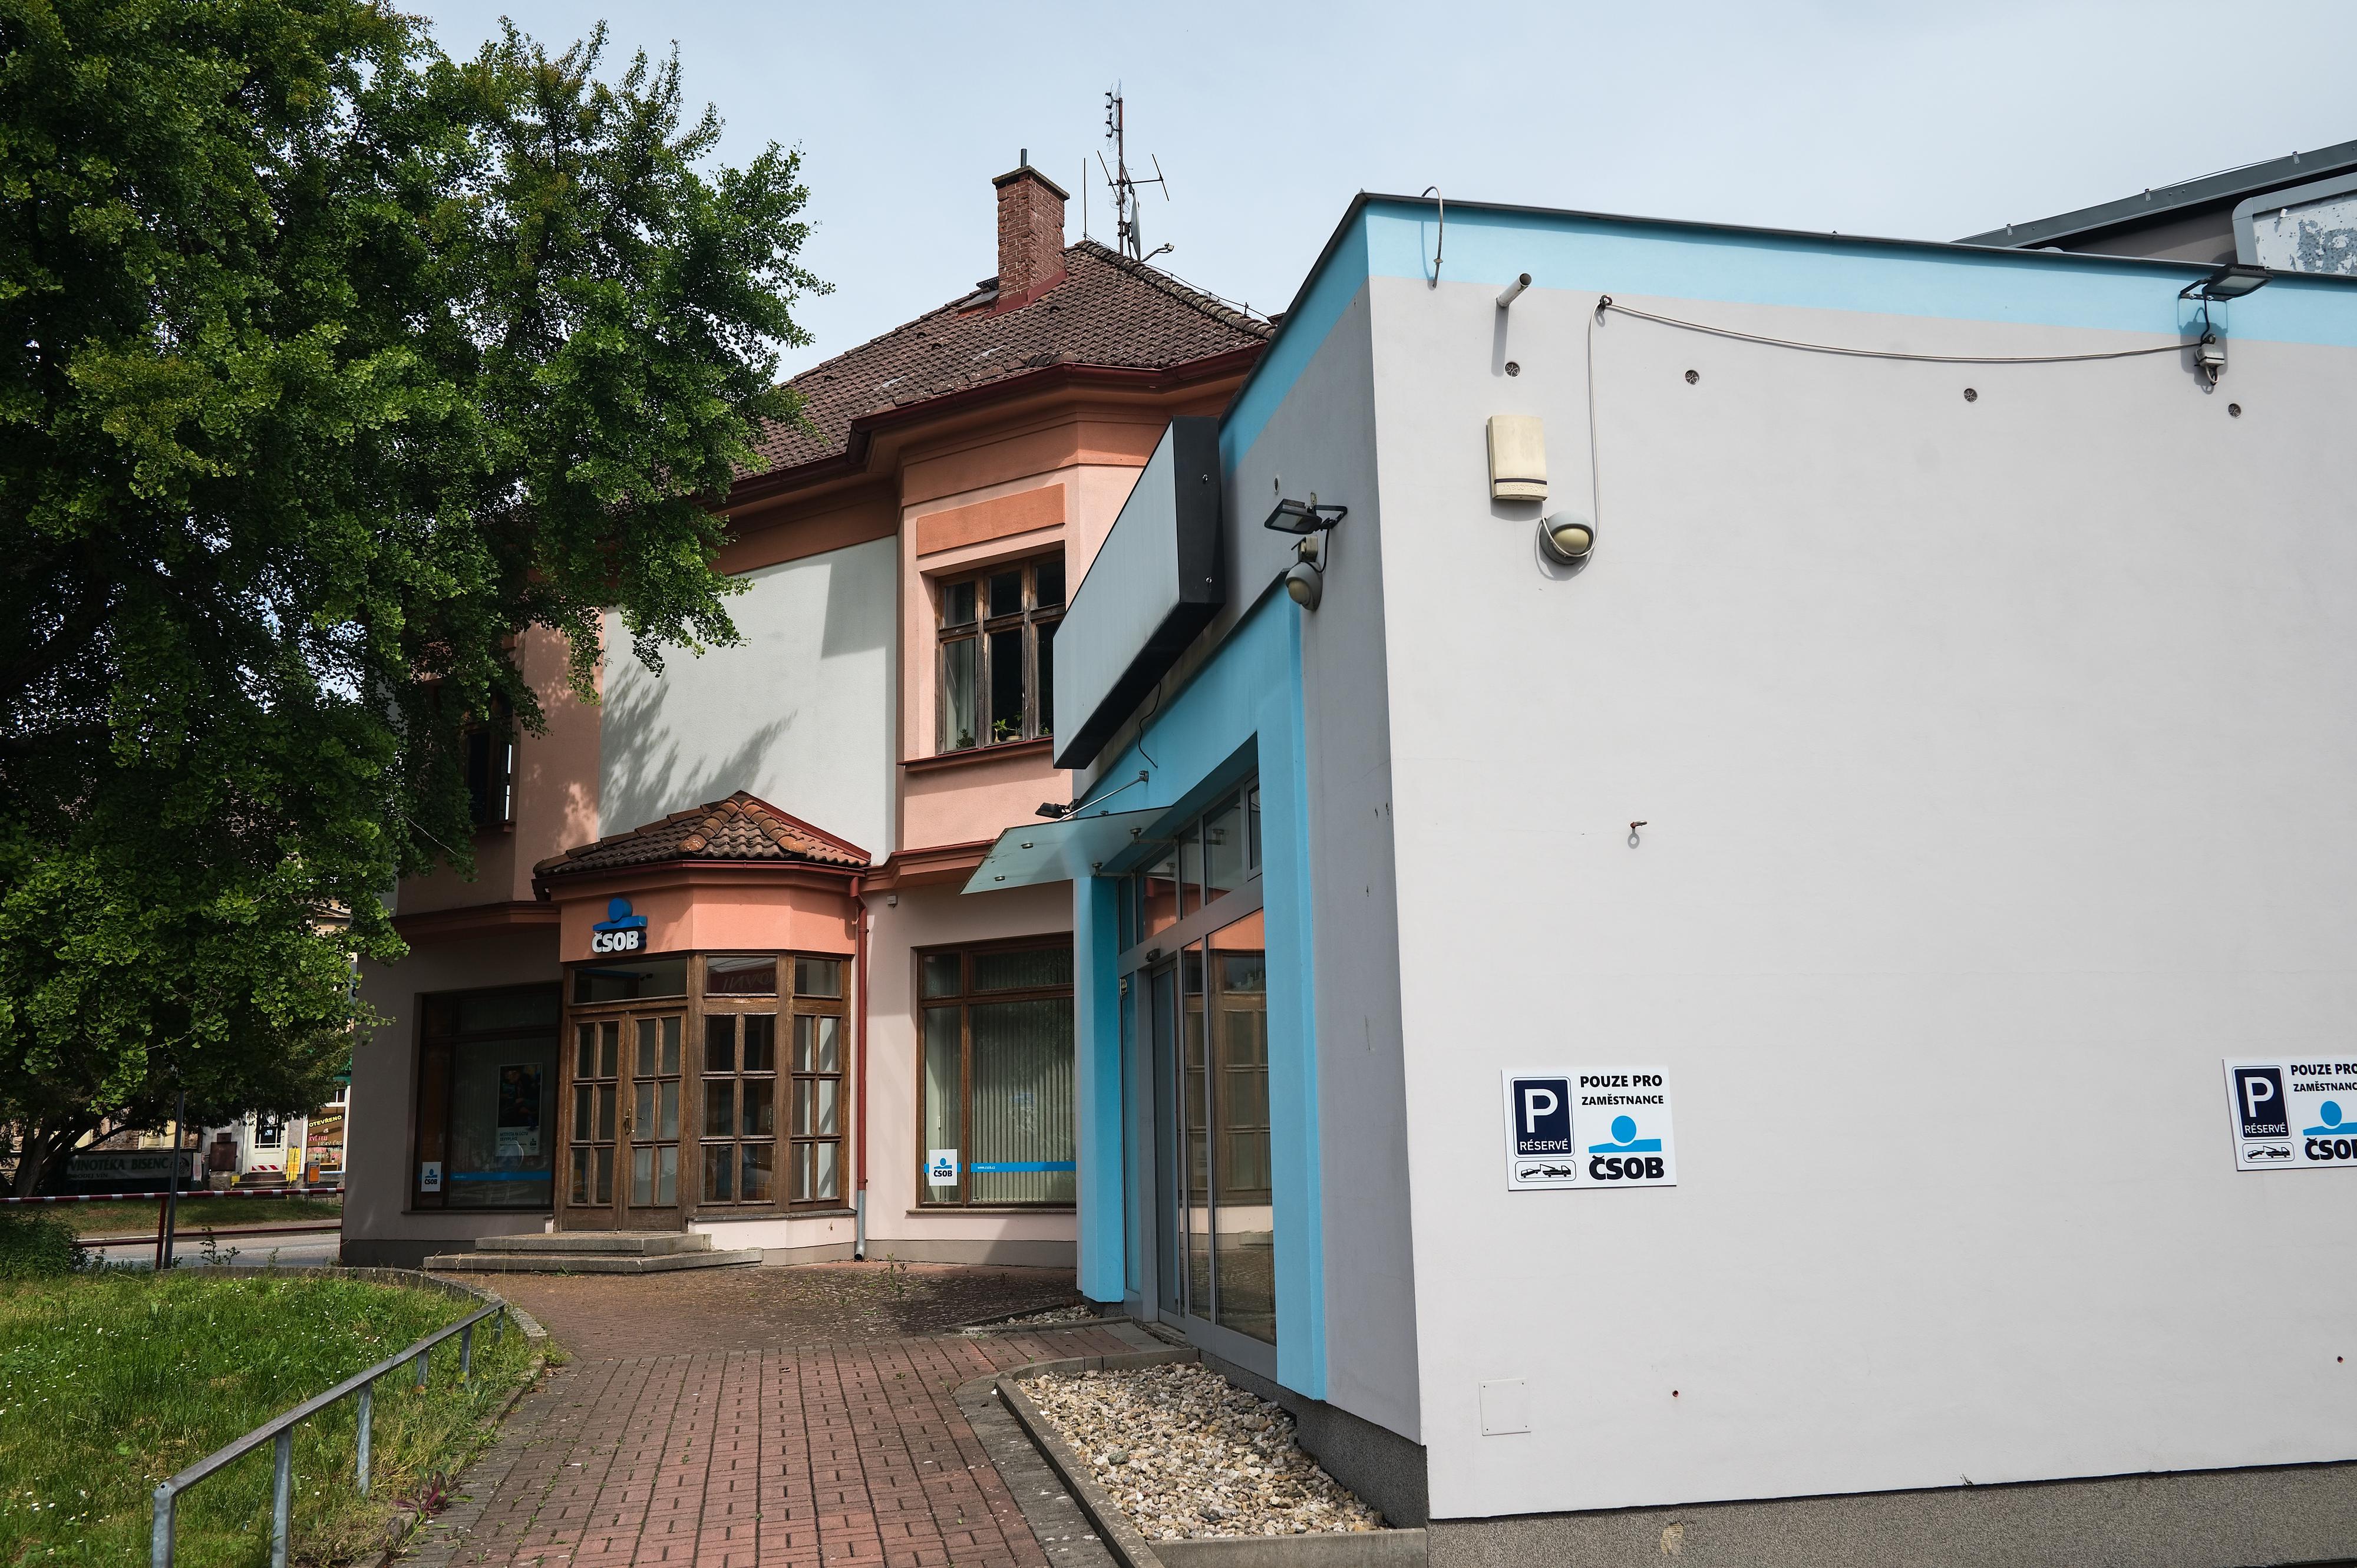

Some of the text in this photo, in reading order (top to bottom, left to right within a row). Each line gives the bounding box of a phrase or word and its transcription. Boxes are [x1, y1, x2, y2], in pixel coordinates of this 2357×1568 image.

[592, 930, 639, 953] ČSOB
[2290, 1064, 2332, 1075] POUZE
[1580, 1074, 1662, 1088] POUZE PRO
[1582, 1094, 1663, 1105] ZAMĚSTNANCE
[2244, 1077, 2274, 1118] P
[1524, 1088, 1558, 1133] P
[309, 1115, 342, 1127] OTEVŘENO
[2244, 1122, 2286, 1134] RÉSERVÉ
[1520, 1138, 1569, 1151] RÉSERVÉ
[69, 1157, 125, 1171] VINOTÉKA
[1589, 1155, 1665, 1180] ČSOB
[933, 1169, 953, 1177] ČSOB
